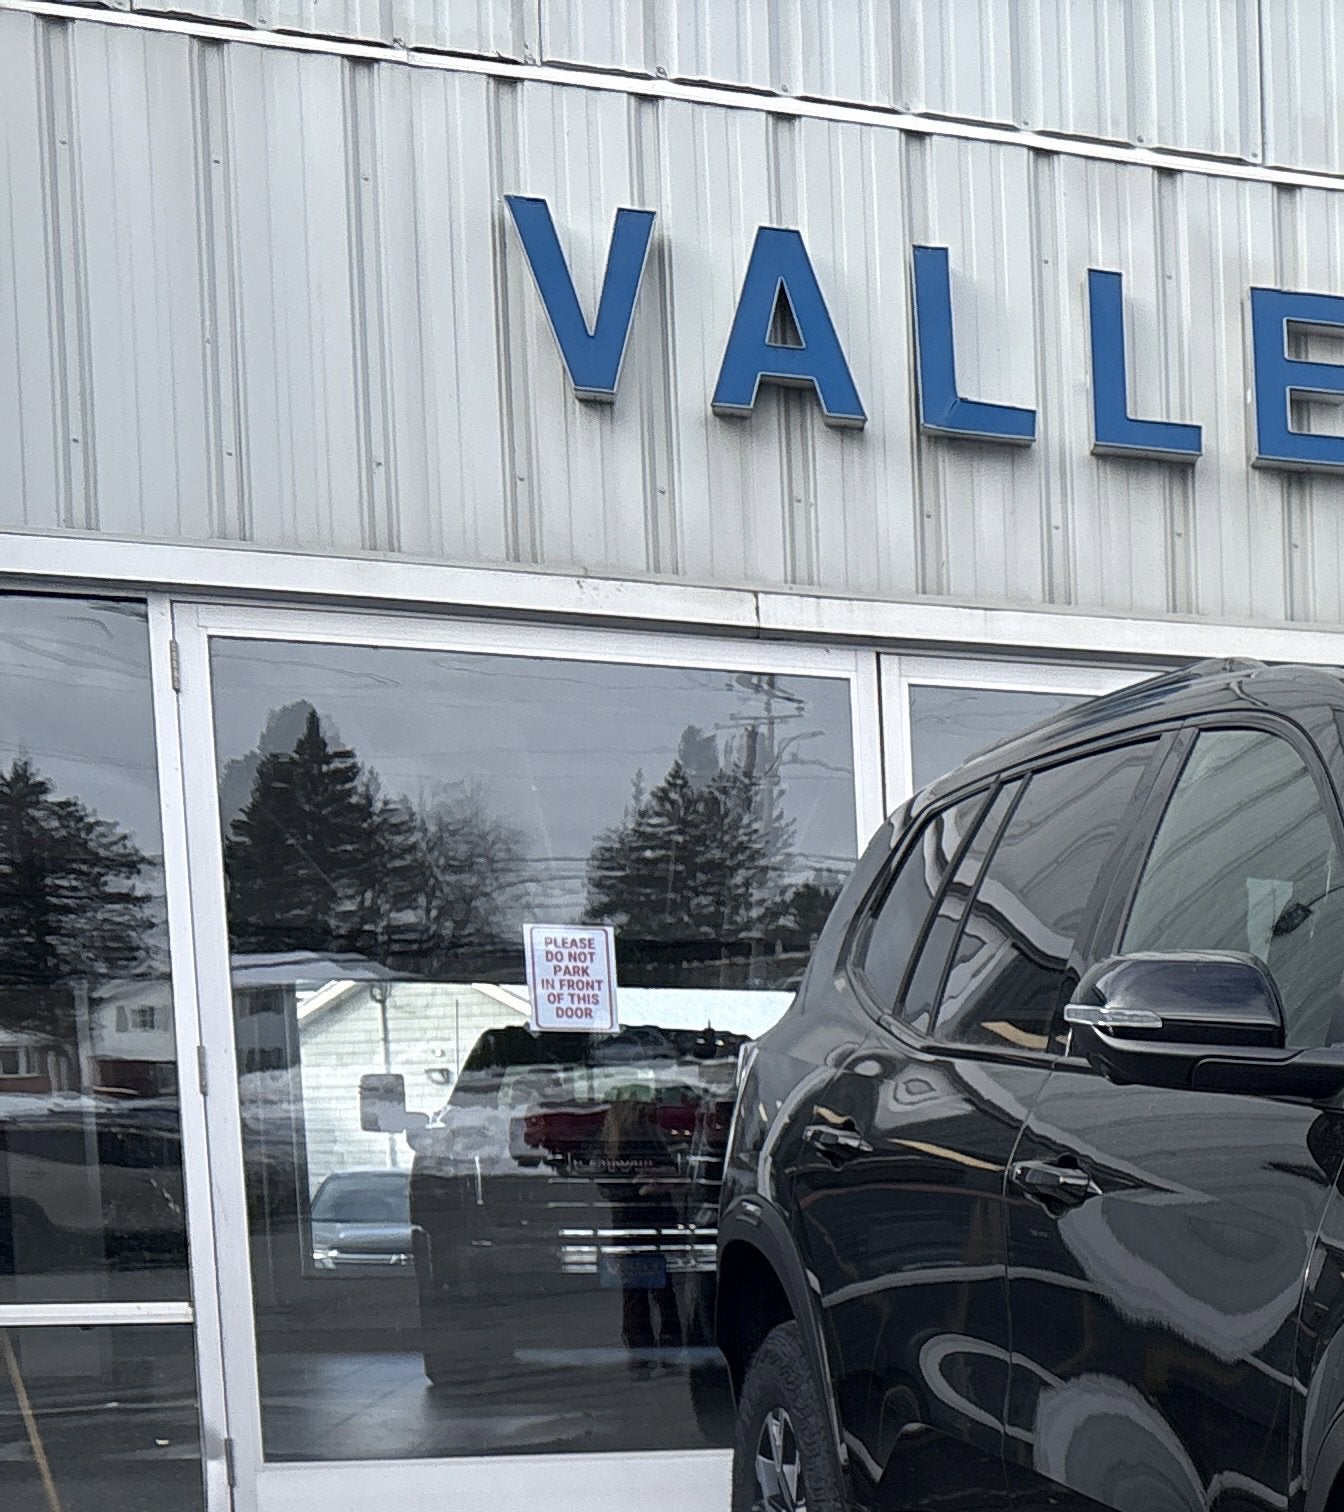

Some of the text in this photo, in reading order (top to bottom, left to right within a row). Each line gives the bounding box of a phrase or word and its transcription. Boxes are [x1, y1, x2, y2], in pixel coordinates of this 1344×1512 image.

[544, 936, 596, 950] PLEASE
[545, 950, 596, 964] DO NOT
[553, 964, 590, 977] PARK
[541, 978, 604, 992] IN FRONT
[547, 992, 600, 1006] OF THIS
[555, 1006, 594, 1020] DOOR
